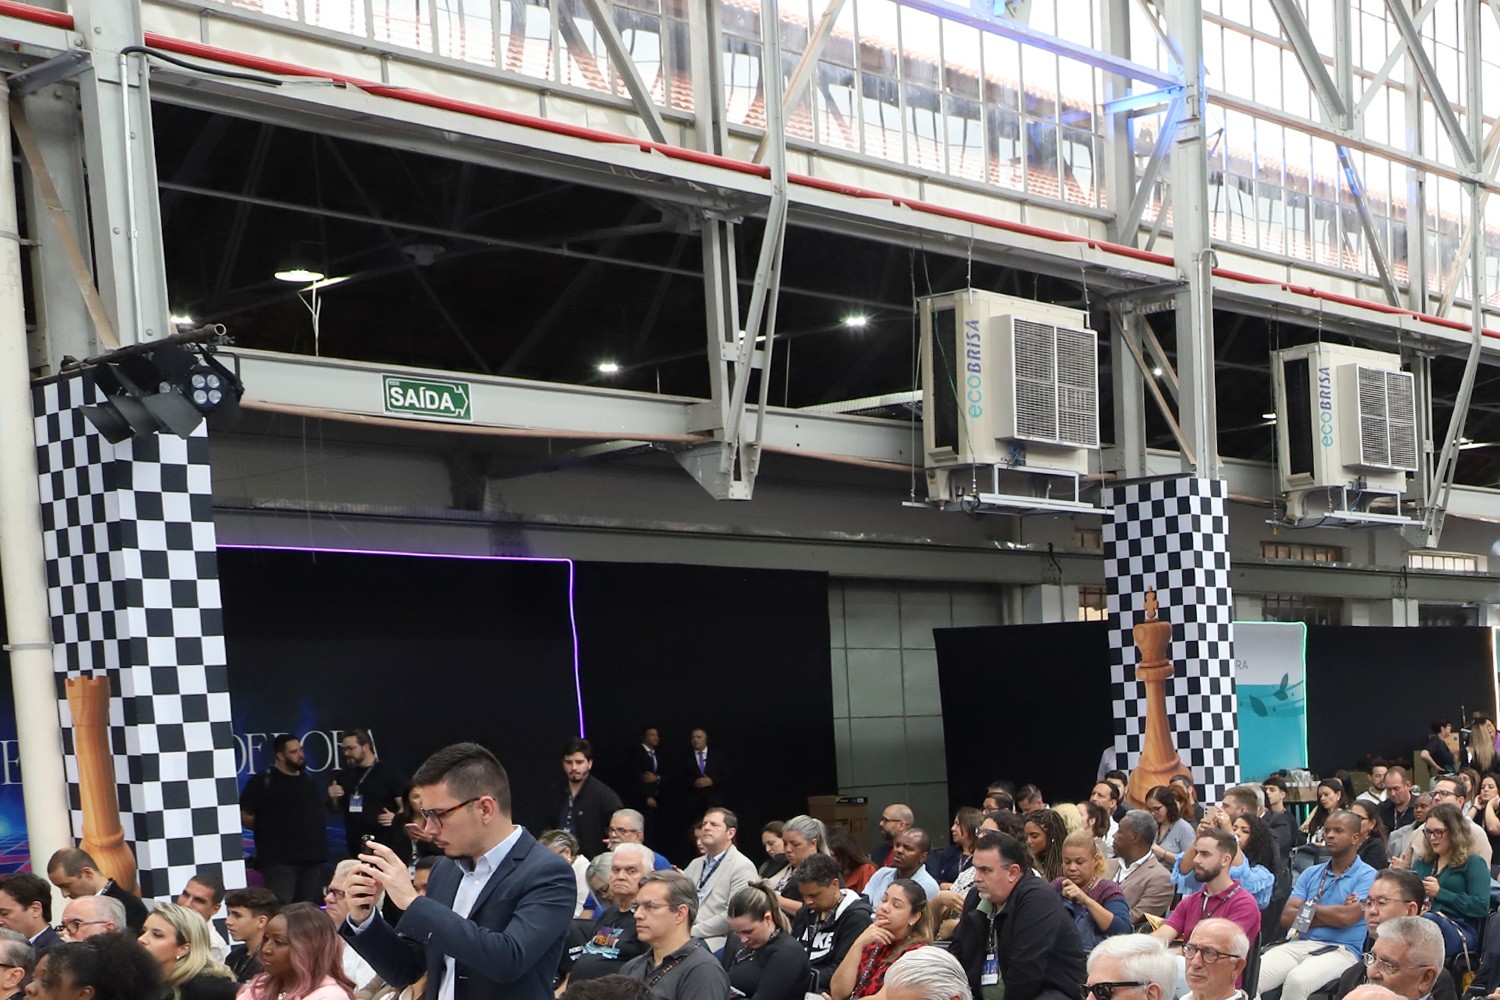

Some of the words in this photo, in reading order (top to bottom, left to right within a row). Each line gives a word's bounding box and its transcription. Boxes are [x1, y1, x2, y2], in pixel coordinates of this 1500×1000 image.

[965, 320, 983, 418] ecoBRISA
[390, 386, 456, 411] SAÍDA
[1319, 367, 1334, 447] ecoBRISA
[1235, 659, 1249, 670] RA
